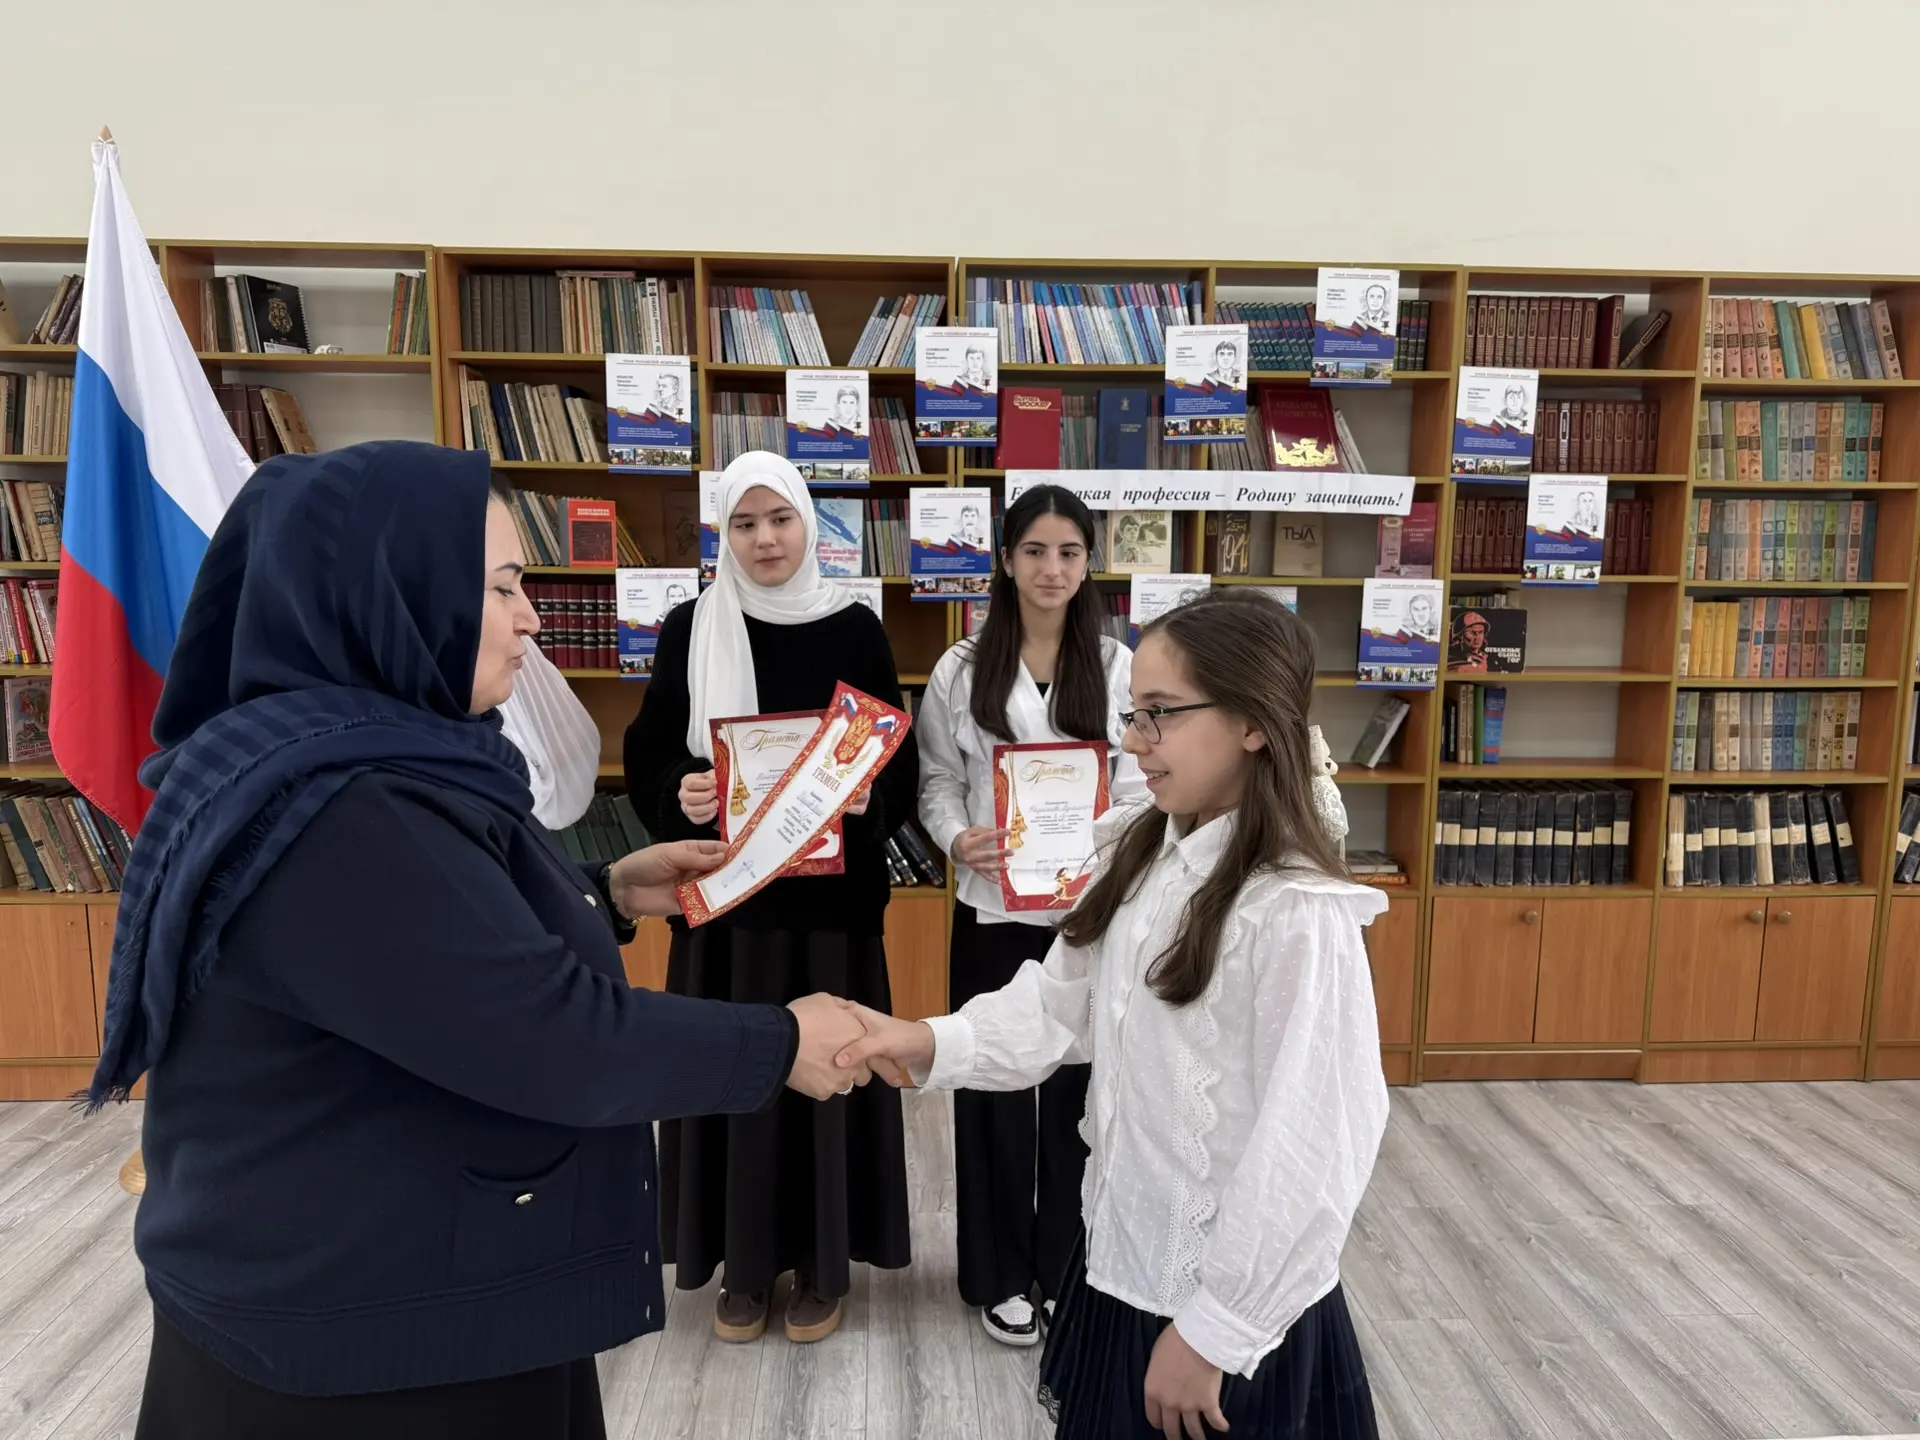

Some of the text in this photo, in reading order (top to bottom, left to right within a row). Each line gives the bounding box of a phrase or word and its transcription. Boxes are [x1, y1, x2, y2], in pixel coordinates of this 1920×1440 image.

[1073, 489, 1111, 501] акая
[1123, 486, 1210, 505] профессия
[1236, 487, 1296, 506] Родину
[1304, 491, 1403, 507] защищать!
[812, 766, 842, 793] ГРАМОТА
[1020, 760, 1084, 787] Грамота
